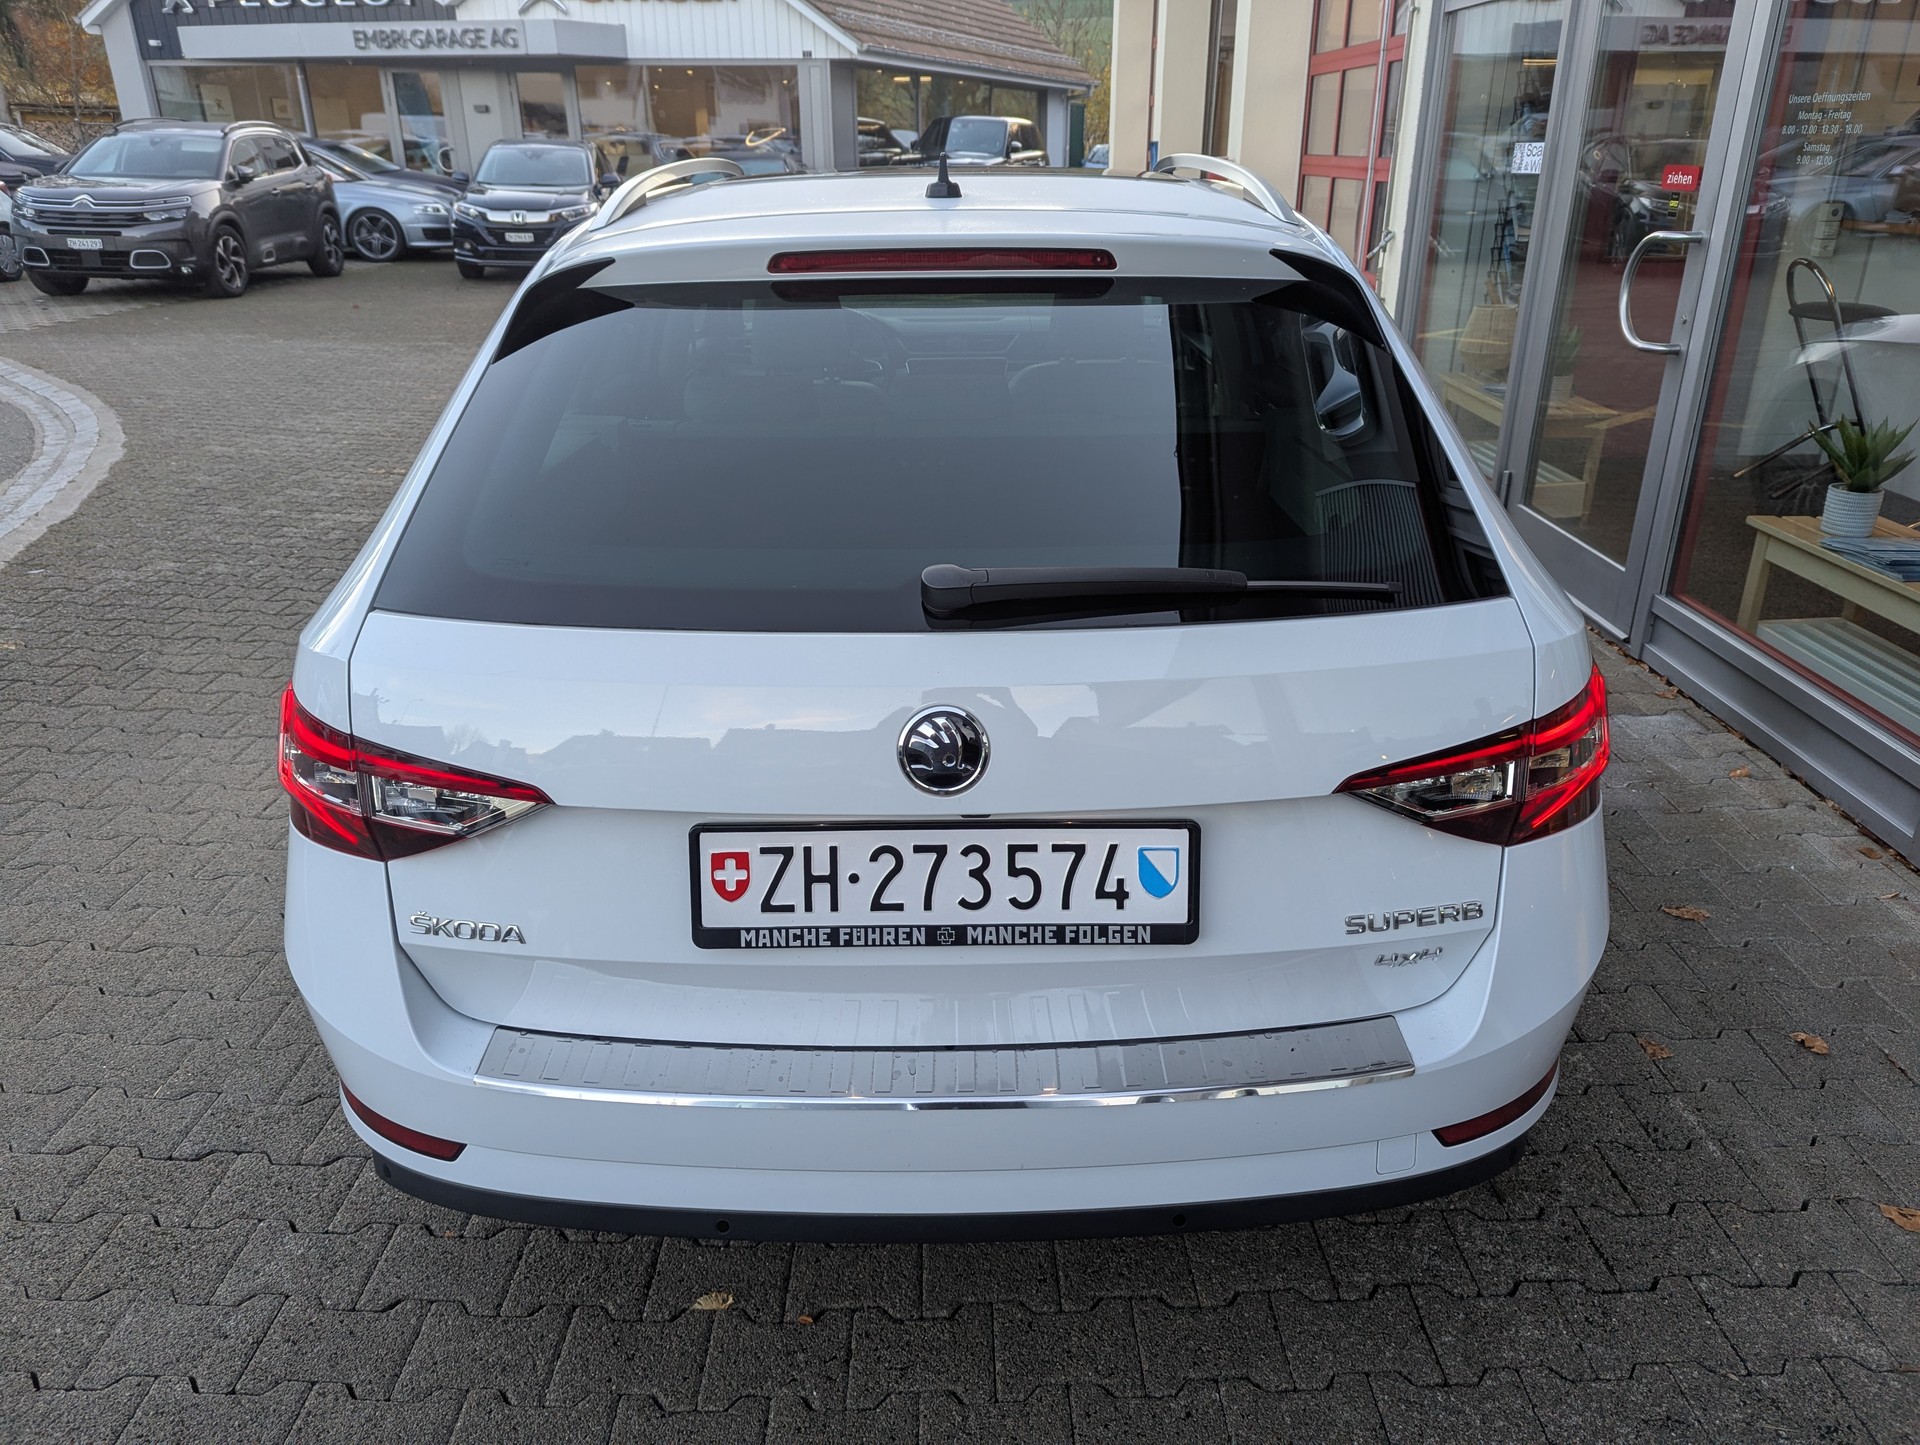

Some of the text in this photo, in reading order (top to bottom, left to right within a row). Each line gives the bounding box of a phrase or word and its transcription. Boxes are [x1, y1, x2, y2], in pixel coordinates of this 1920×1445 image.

[491, 27, 519, 49] AG
[1788, 91, 1871, 104] Unsere Oeffnungszeiten
[1797, 110, 1823, 122] Montag
[1828, 109, 1852, 122] Freitag
[1803, 142, 1830, 154] Samstag
[1667, 171, 1693, 185] ziehen
[1344, 900, 1484, 935] SUPERB
[409, 910, 527, 945] ŠKODA
[740, 925, 1151, 947] MANCHE FÜHREN MANCHE FOLGEN
